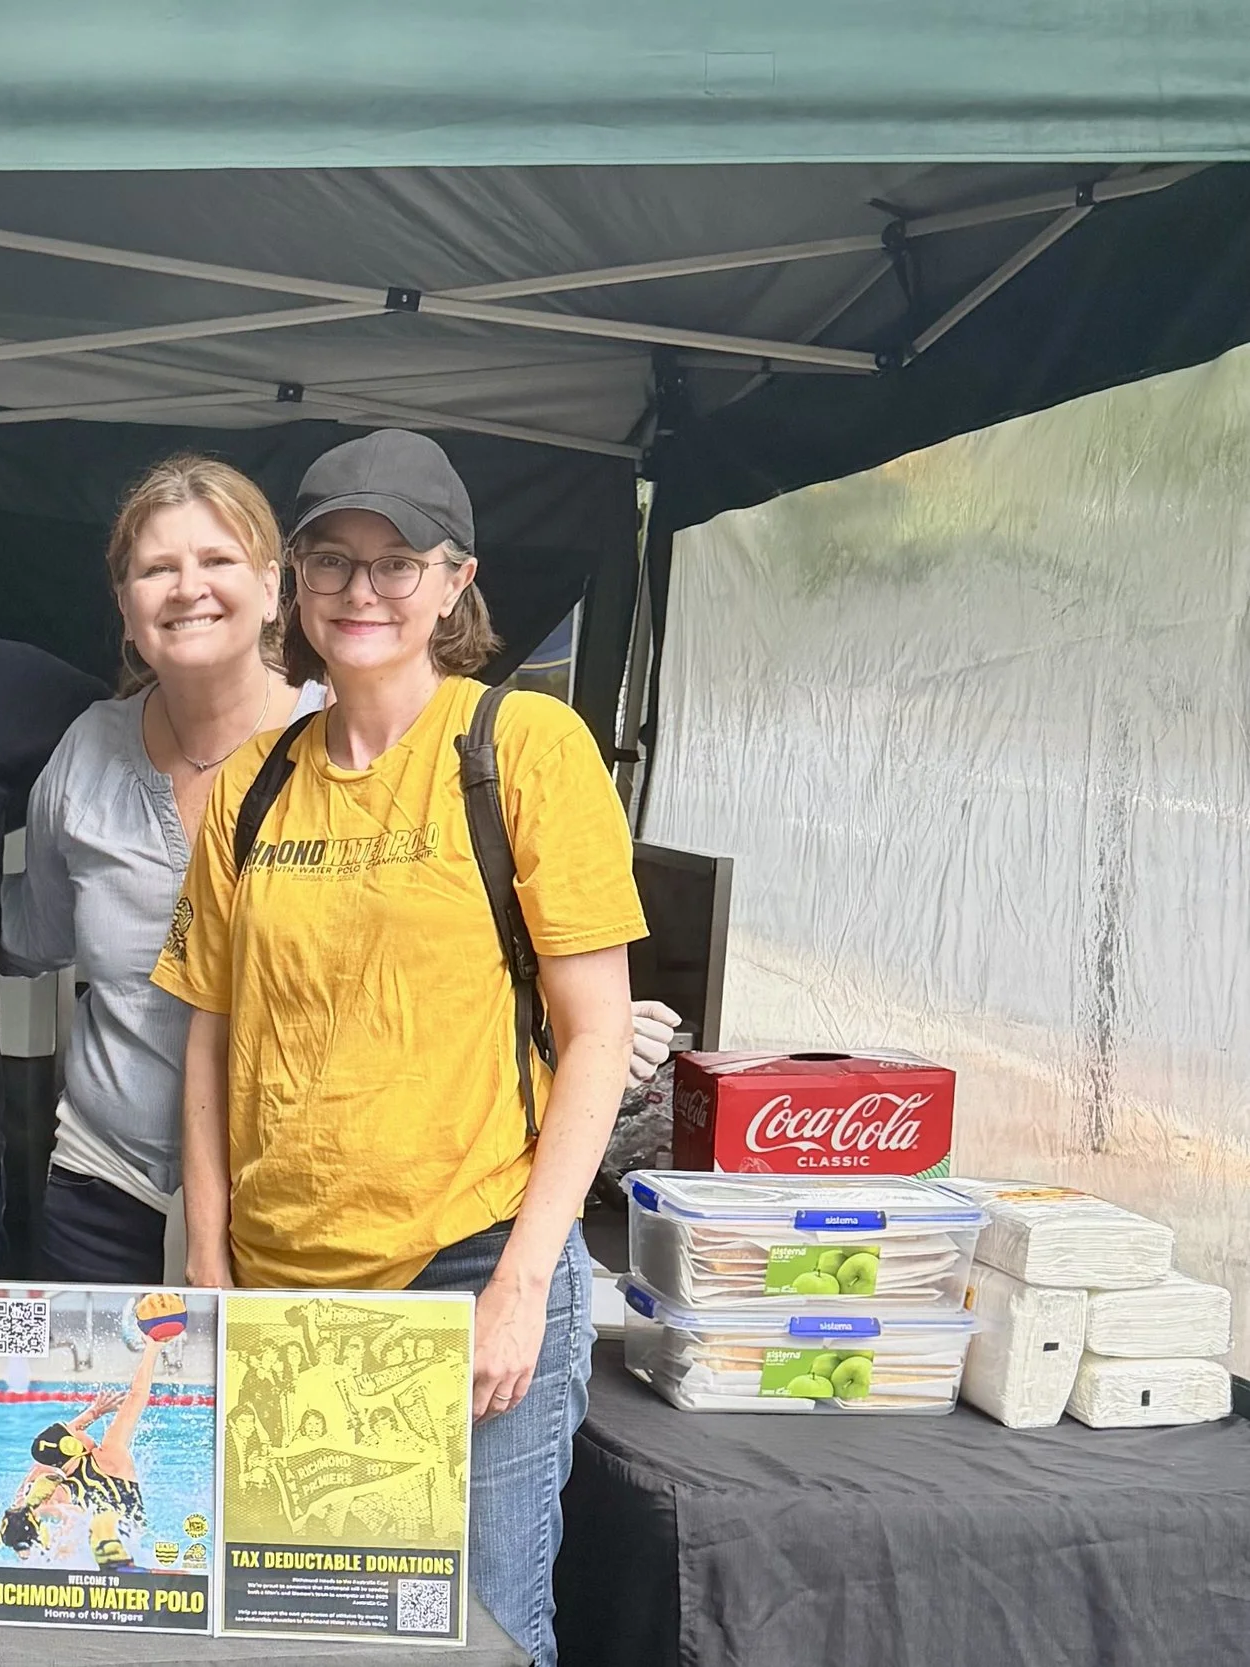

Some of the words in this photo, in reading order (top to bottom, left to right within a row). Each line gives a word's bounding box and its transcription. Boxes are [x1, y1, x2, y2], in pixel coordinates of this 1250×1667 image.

[299, 866, 332, 874] WATER
[337, 865, 361, 875] POLO
[745, 1092, 934, 1153] Coca-Cola
[797, 1156, 870, 1167] CLASSIC
[825, 1216, 858, 1225] sistema
[771, 1247, 807, 1256] sistema
[819, 1322, 853, 1331] sistema
[766, 1350, 802, 1359] sistema
[297, 1455, 351, 1479] RICHMOND
[231, 1550, 260, 1568] TAX
[265, 1552, 362, 1572] DEDUCTABLE
[366, 1555, 455, 1575] DONATIONS
[68, 1575, 107, 1586] WELCOME
[108, 1576, 120, 1587] TO
[89, 1587, 150, 1611] WATER
[154, 1590, 205, 1614] POLO
[44, 1608, 75, 1619] Home
[78, 1610, 89, 1620] of
[90, 1610, 108, 1621] the
[110, 1611, 144, 1623] Tigers
